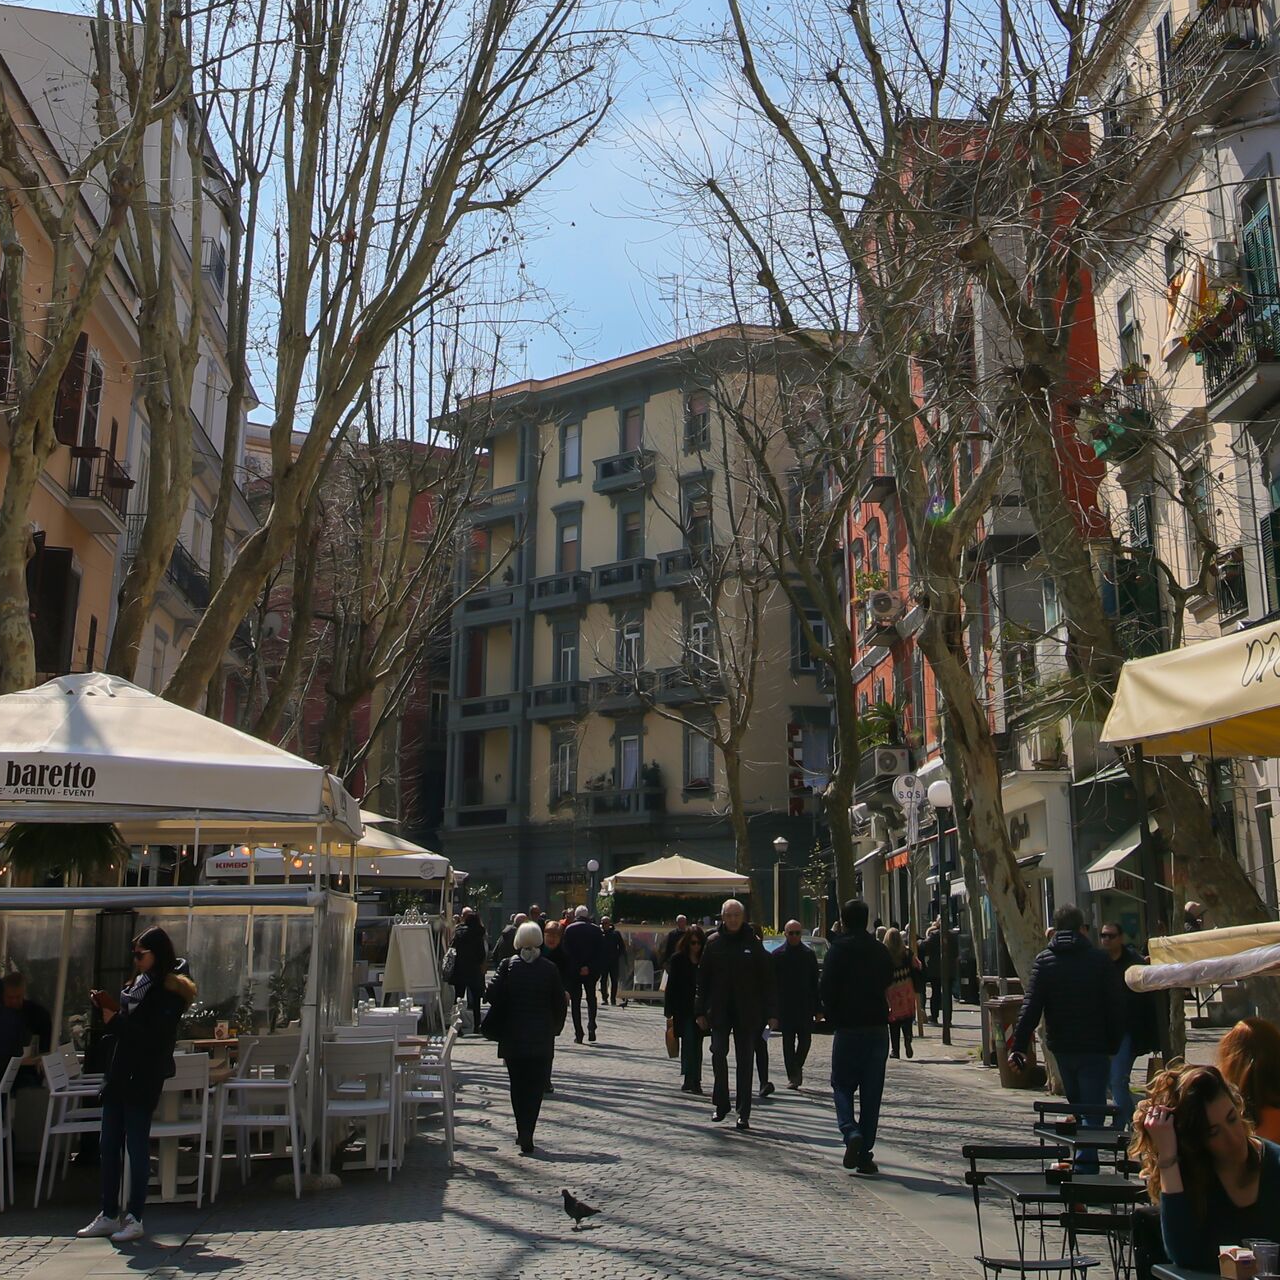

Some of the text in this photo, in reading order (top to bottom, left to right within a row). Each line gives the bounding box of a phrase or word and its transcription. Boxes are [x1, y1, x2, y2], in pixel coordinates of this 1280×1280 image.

[5, 760, 97, 789] baretto
[13, 787, 56, 796] APERITIVI
[63, 788, 95, 797] EVENTI
[215, 861, 249, 869] KIMBO
